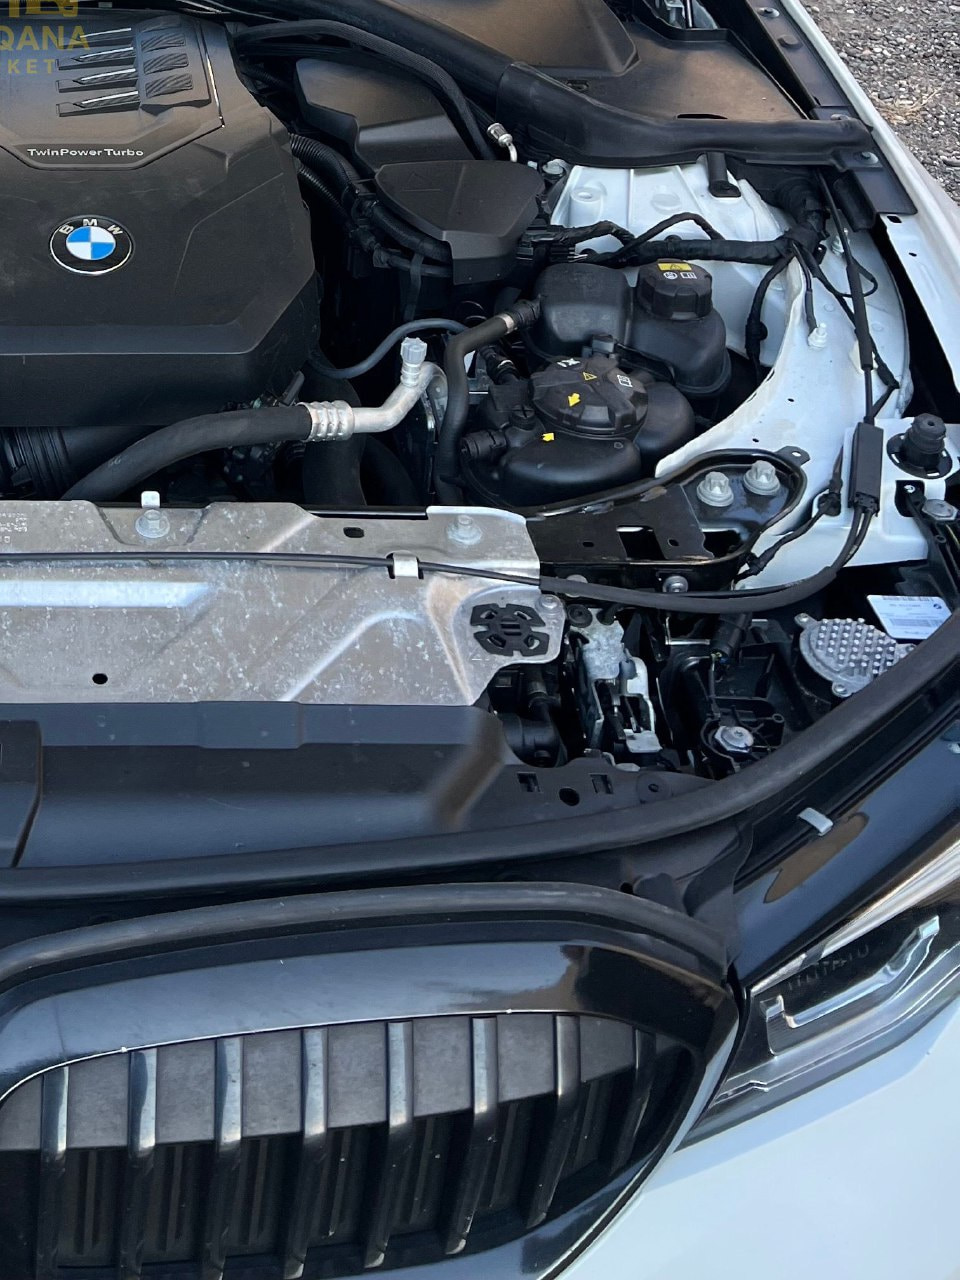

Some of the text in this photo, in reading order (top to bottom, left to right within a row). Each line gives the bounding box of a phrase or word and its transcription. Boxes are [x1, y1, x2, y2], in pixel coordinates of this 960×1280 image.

[27, 148, 144, 157] TwinPower Turbo
[58, 218, 124, 235] BMW
